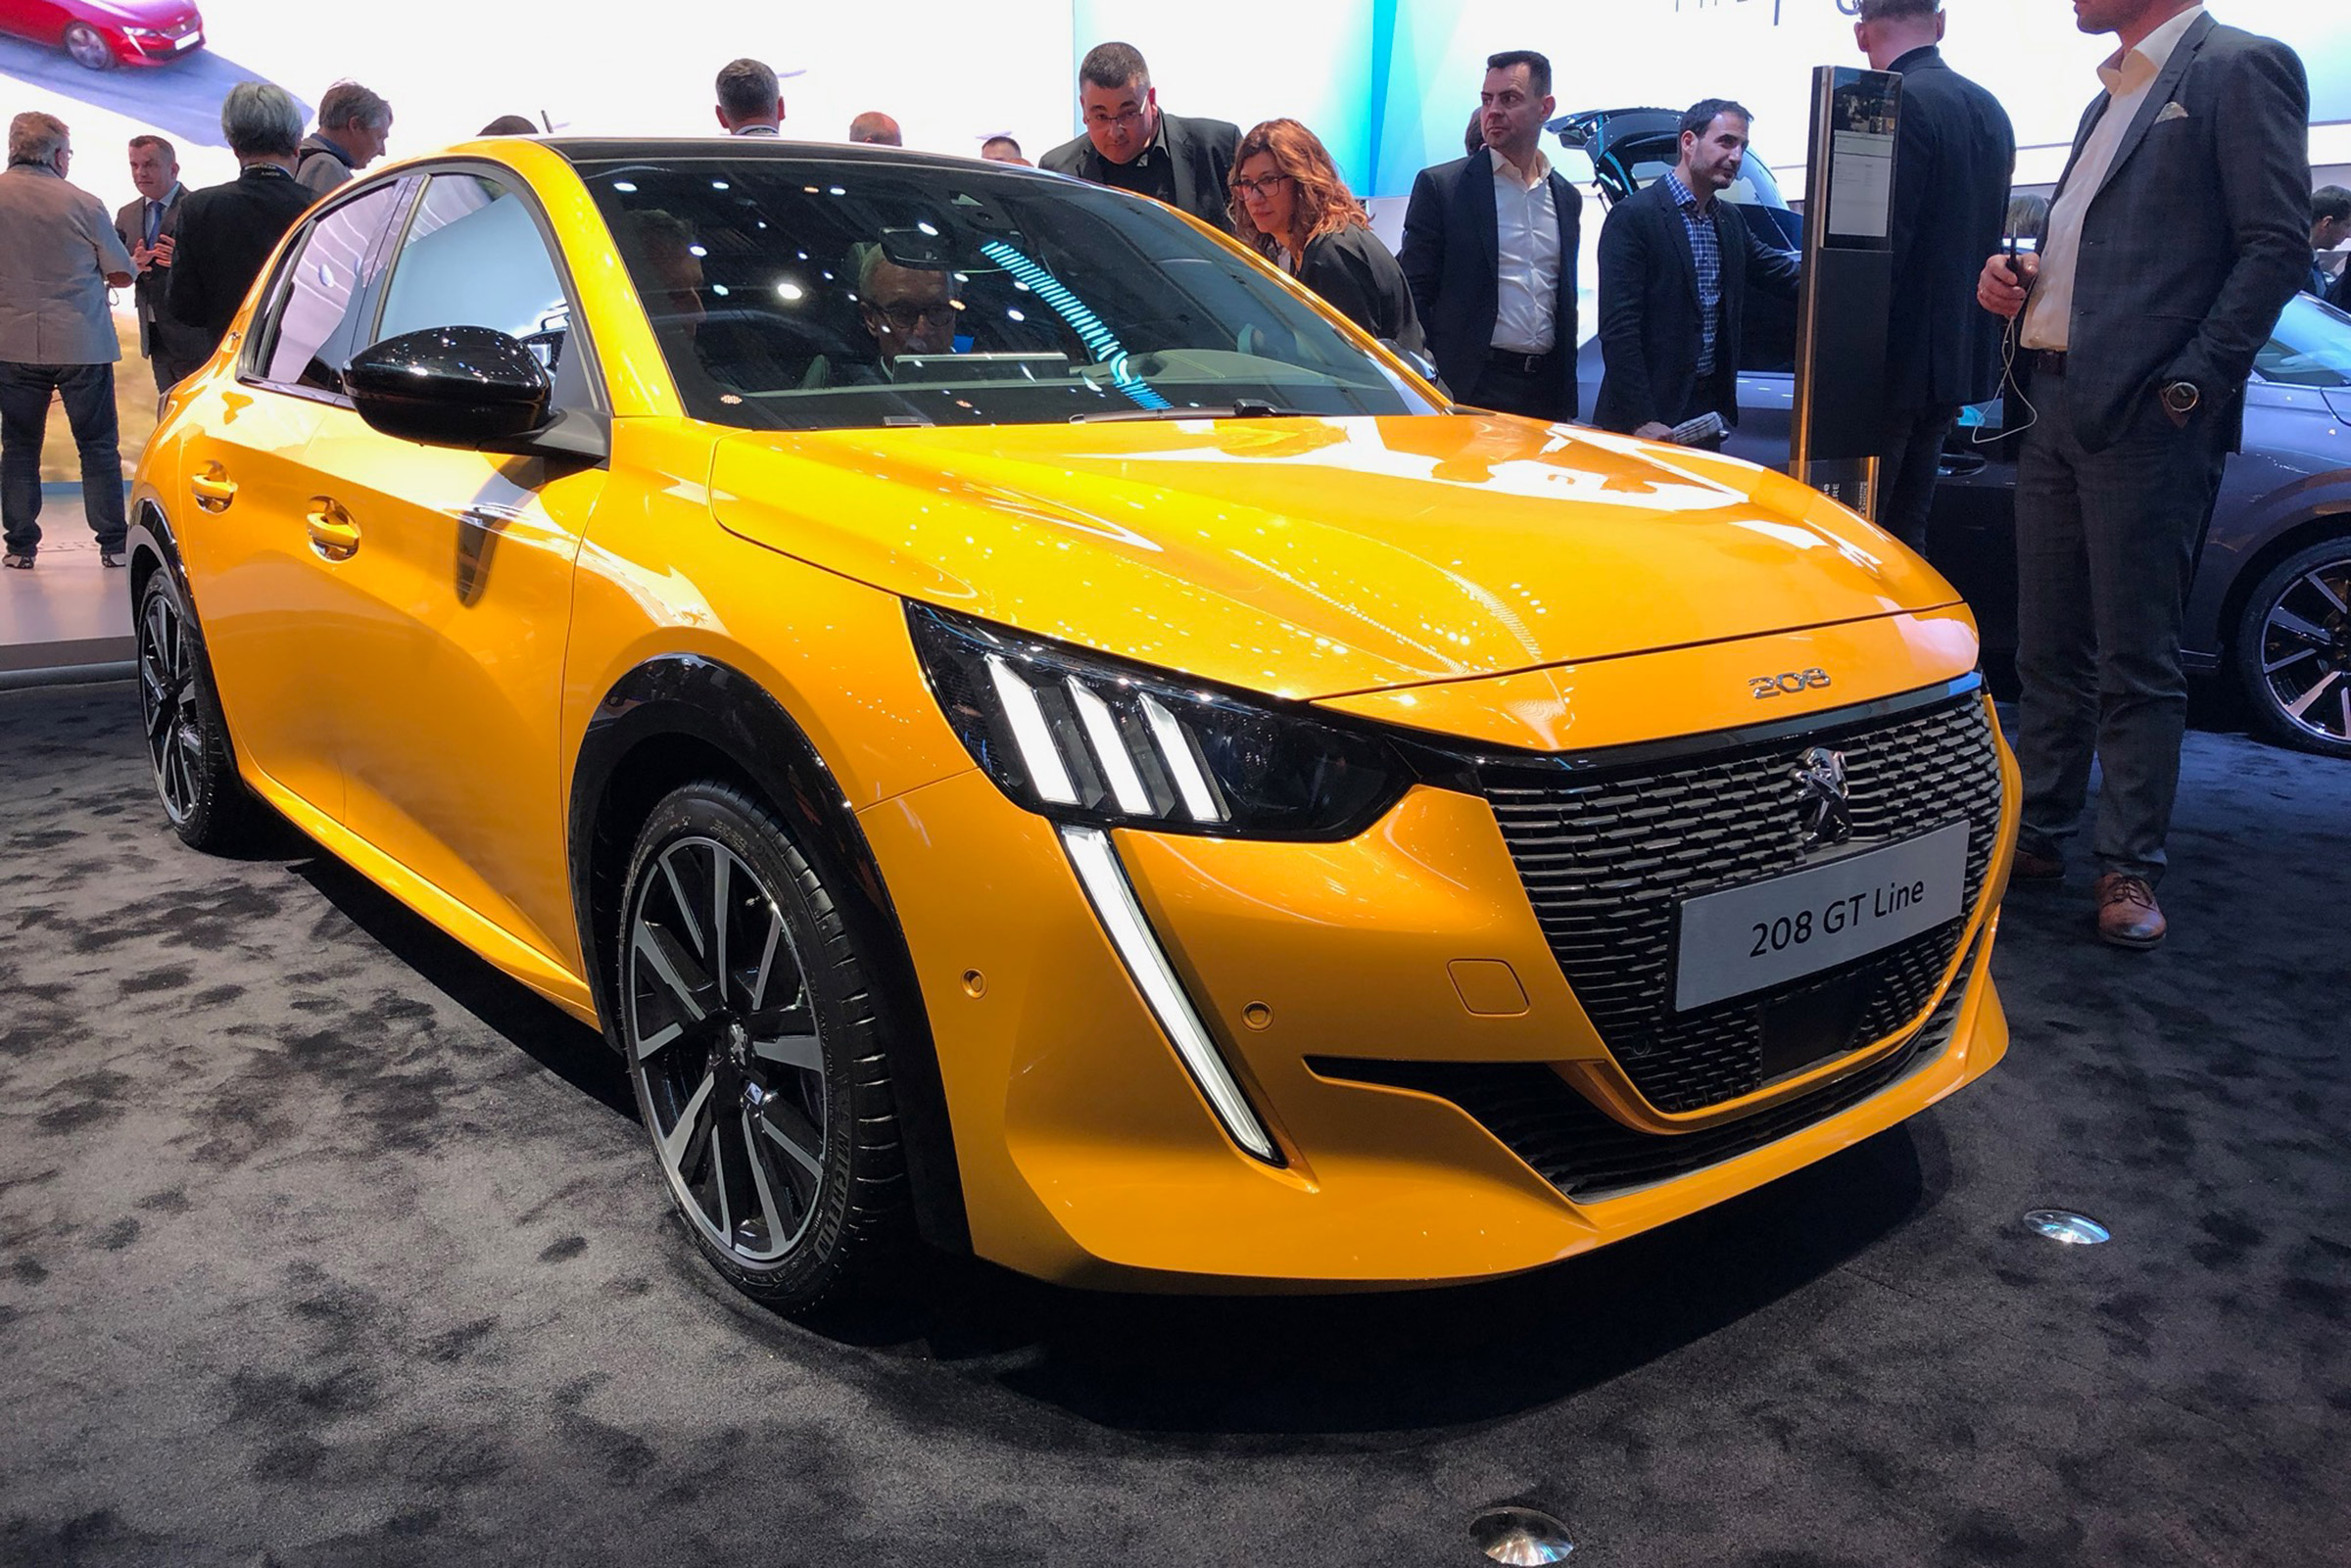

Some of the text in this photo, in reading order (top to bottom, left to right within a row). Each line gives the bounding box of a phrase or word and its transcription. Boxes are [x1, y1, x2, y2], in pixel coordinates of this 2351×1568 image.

[1749, 668, 1831, 699] 208
[1750, 880, 1924, 957] 208 GT Line
[816, 1130, 851, 1259] MICHELIN
